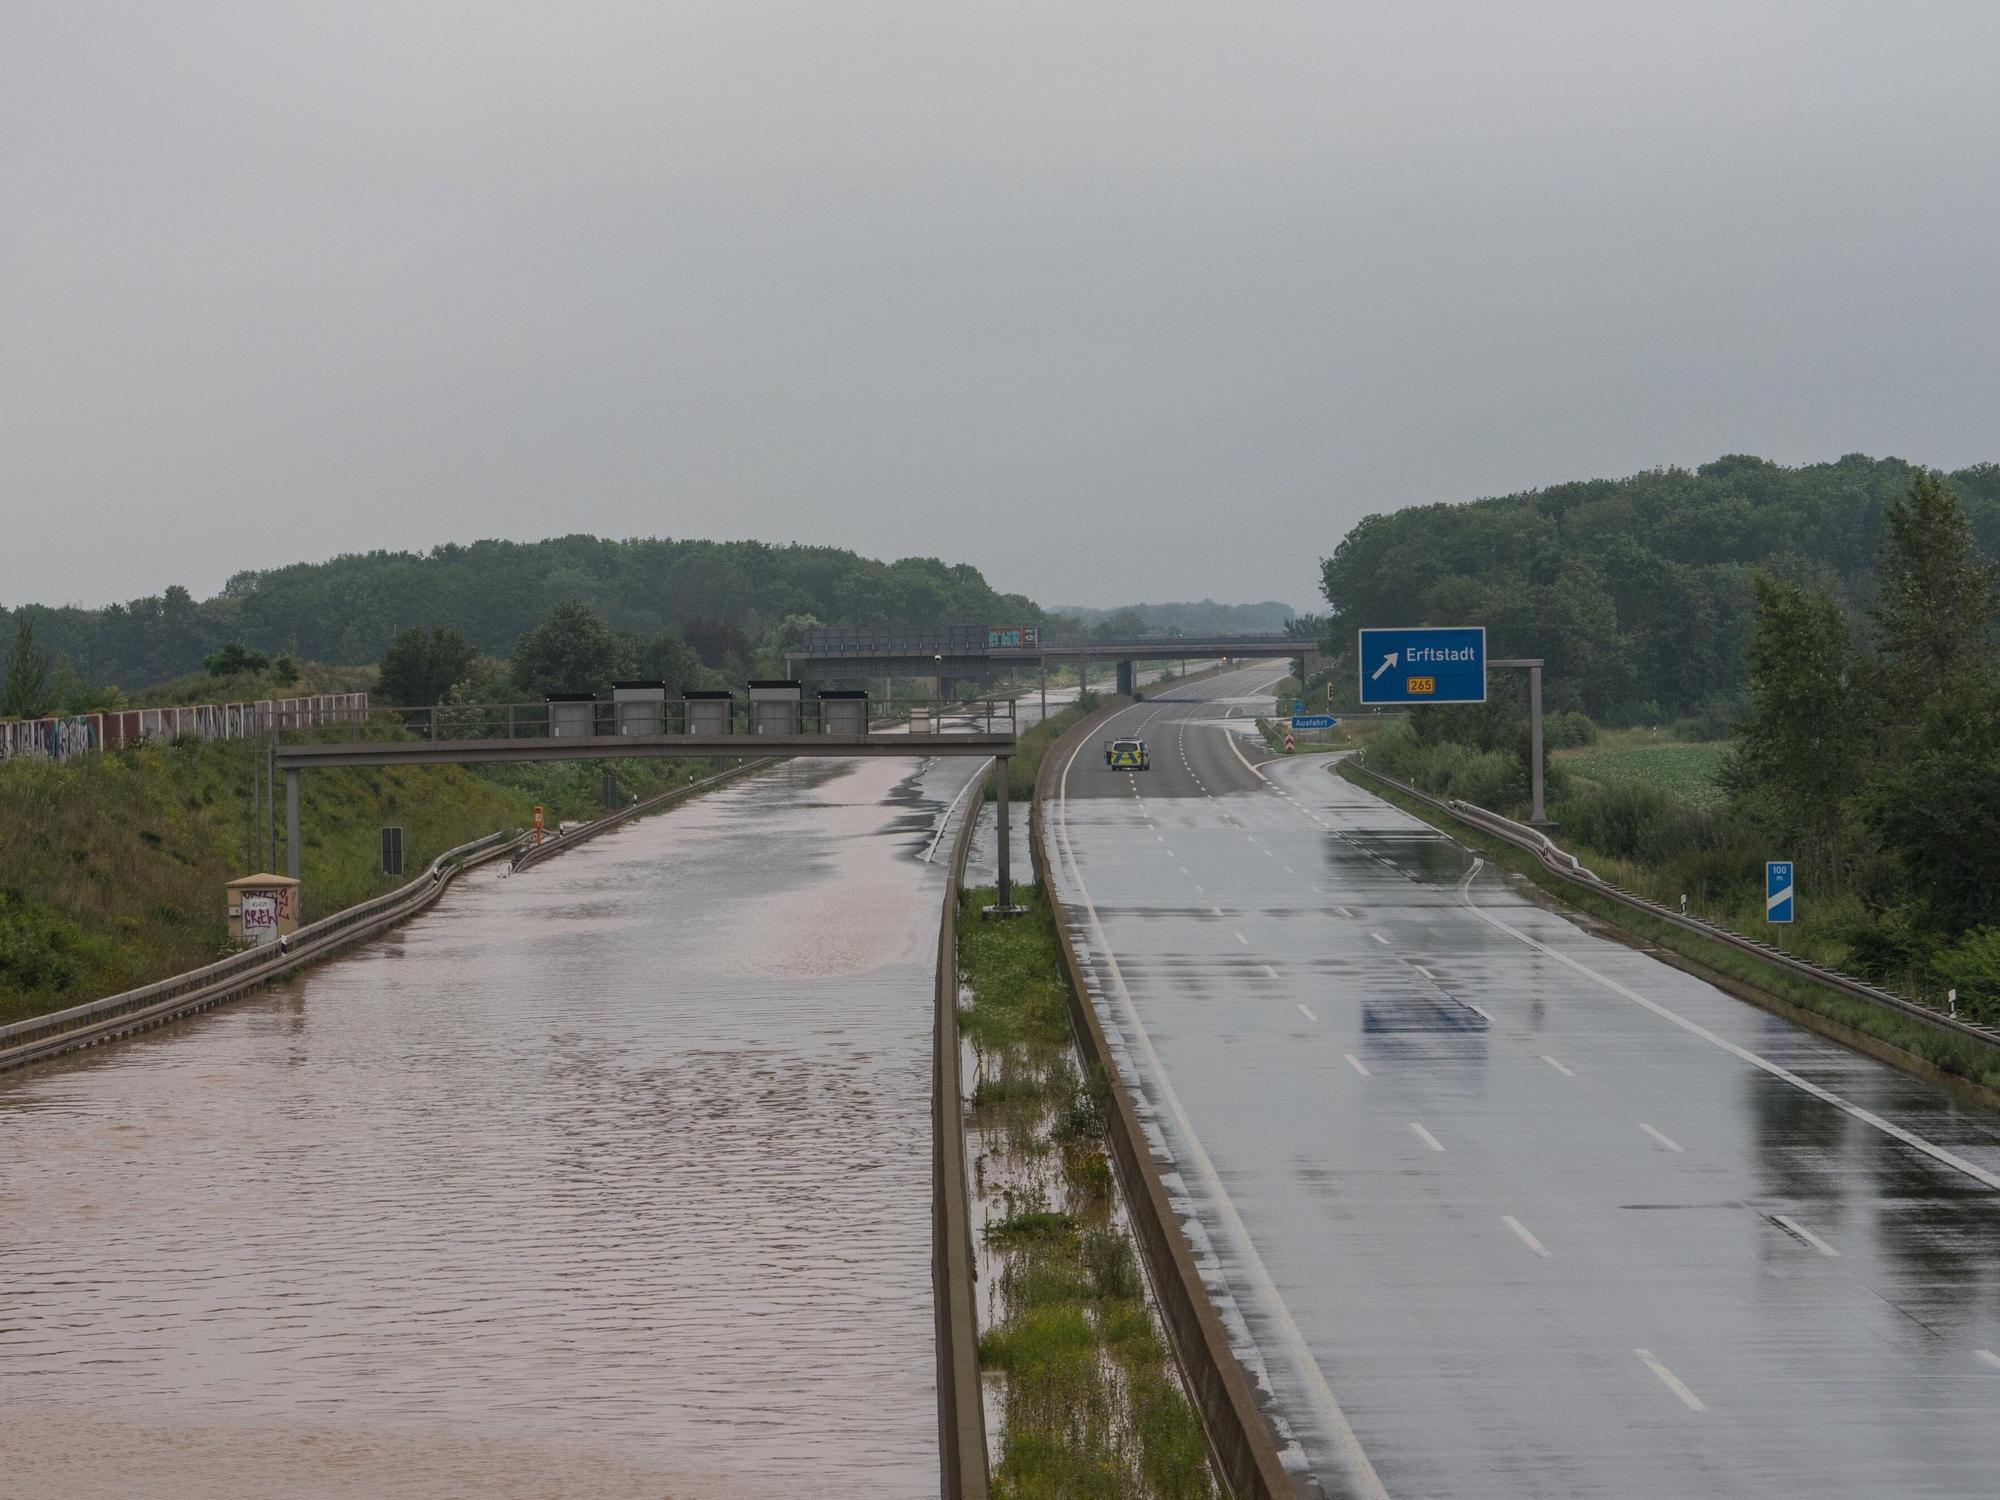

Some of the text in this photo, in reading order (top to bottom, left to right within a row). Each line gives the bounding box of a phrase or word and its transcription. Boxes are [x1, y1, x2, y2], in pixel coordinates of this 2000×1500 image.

[1406, 647, 1475, 662] Erftstadt
[1410, 680, 1432, 691] 265
[1295, 719, 1328, 727] Ausfahrt
[1773, 866, 1787, 874] 100
